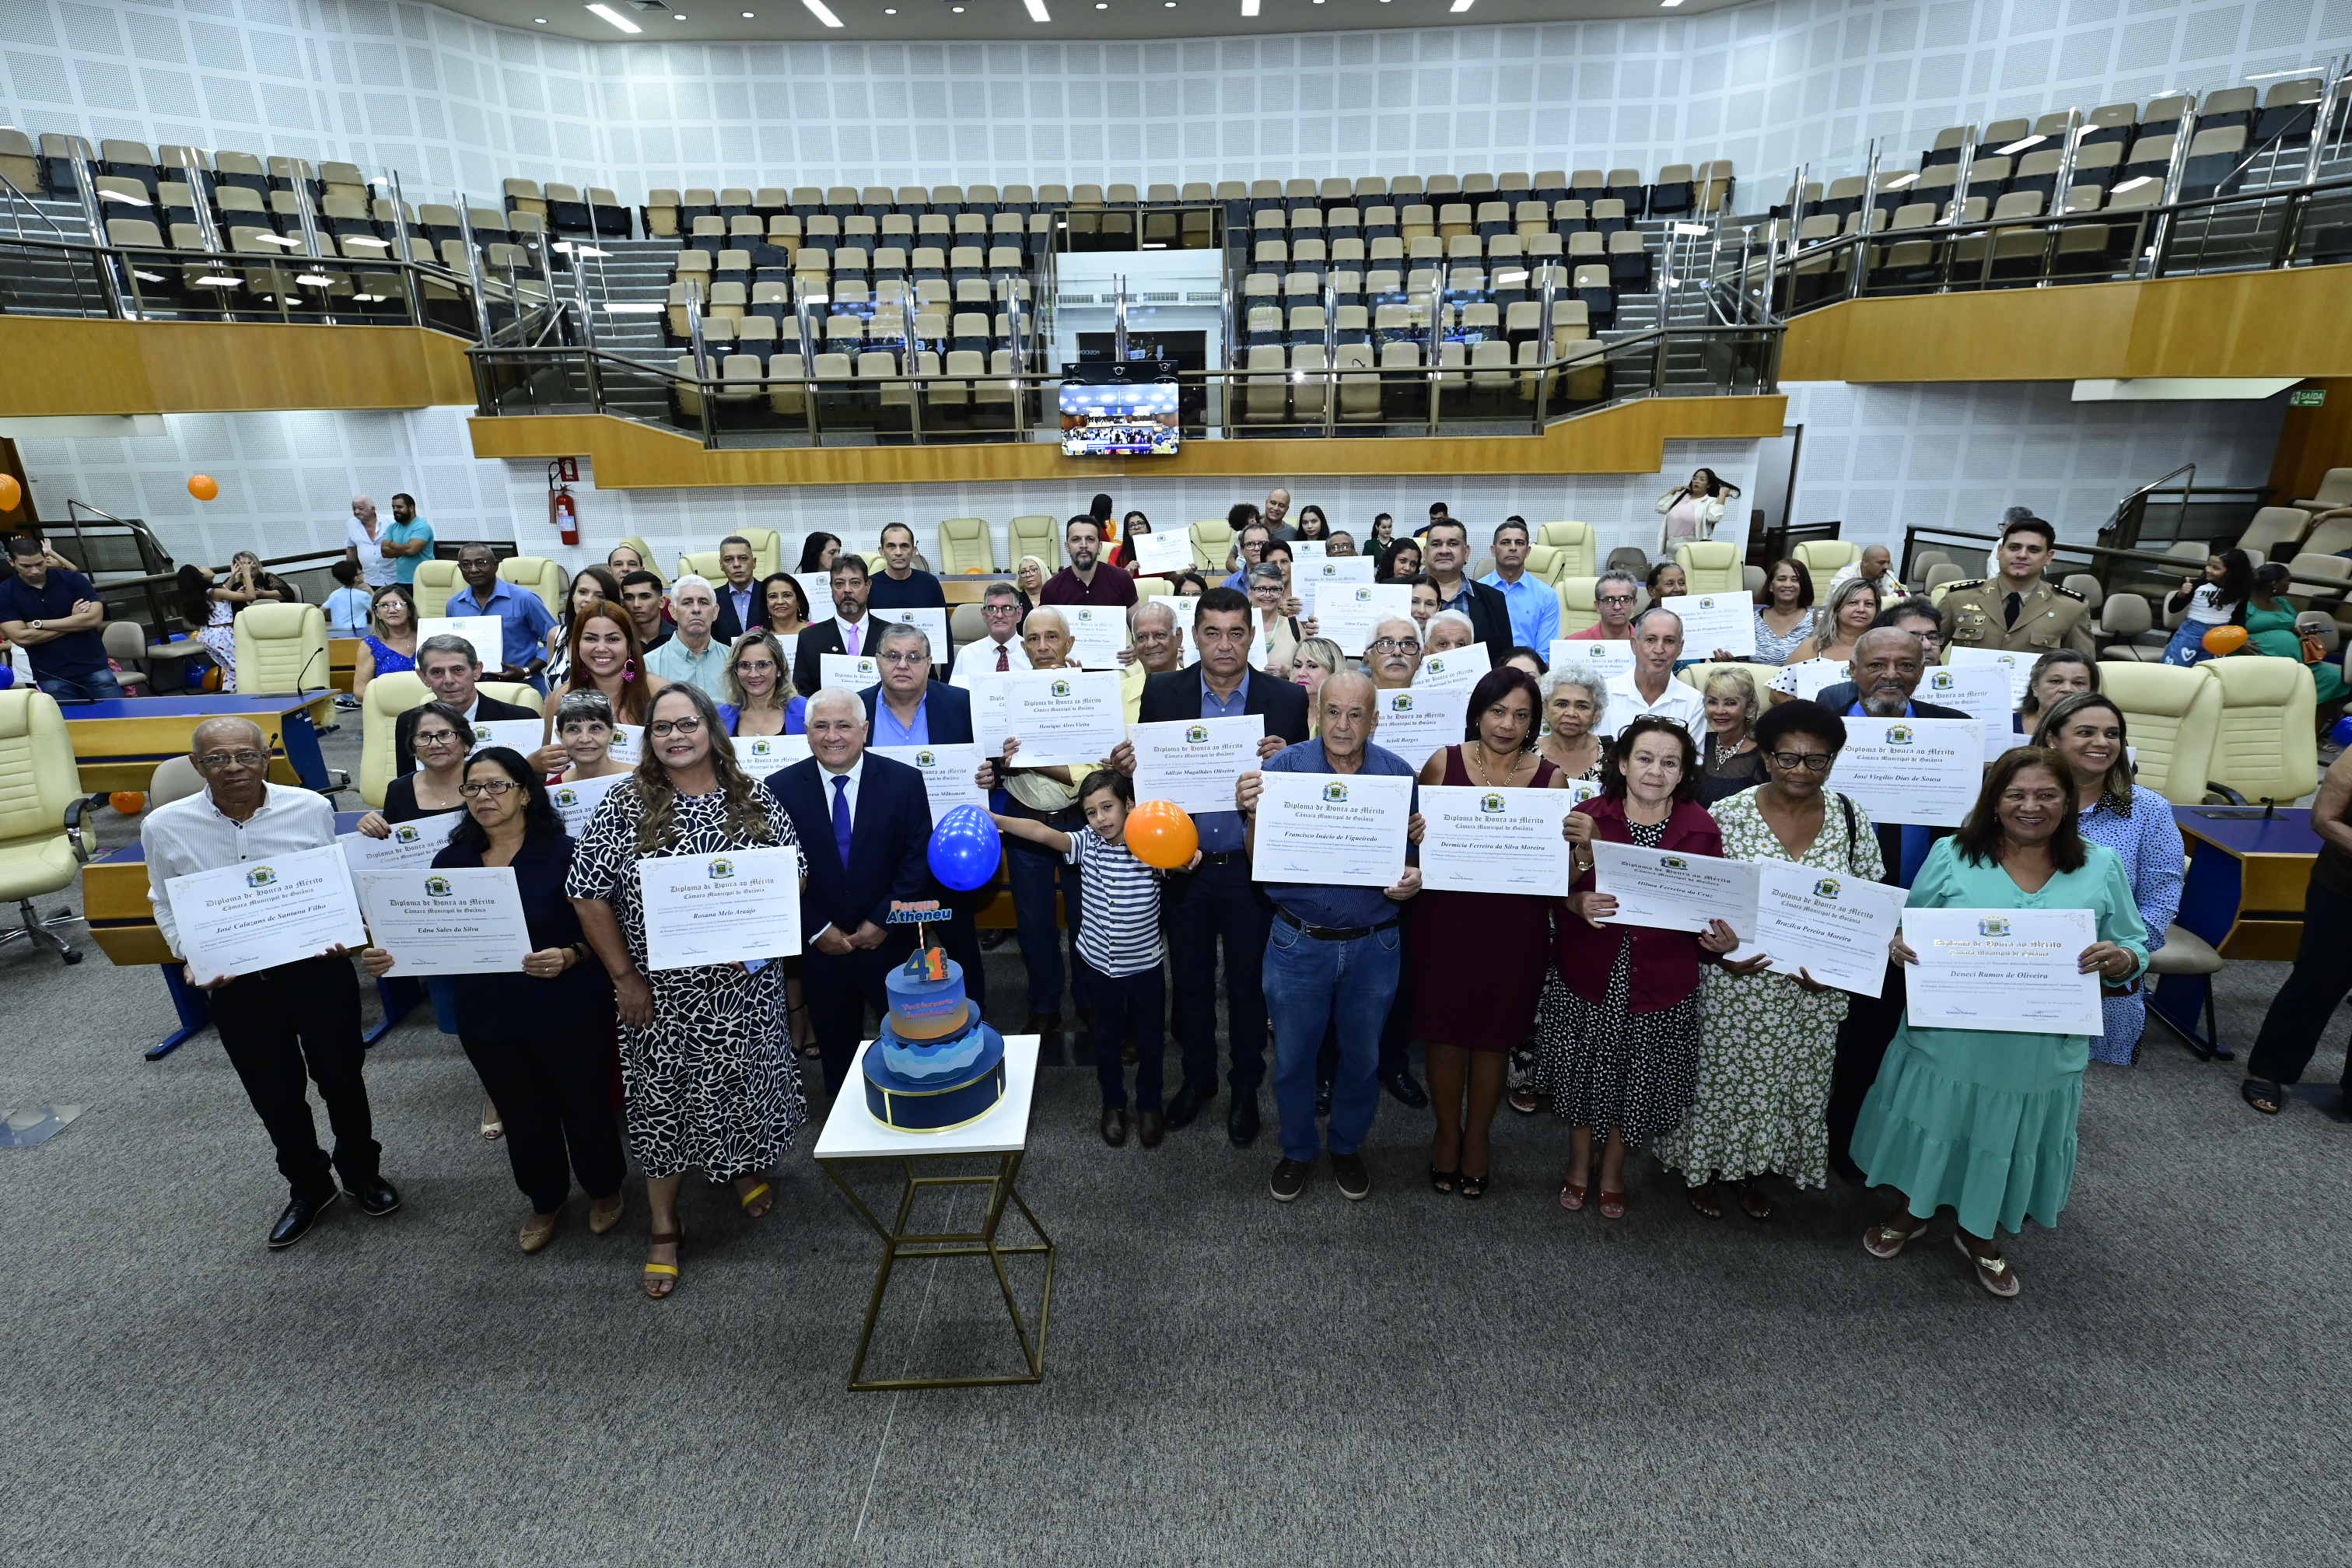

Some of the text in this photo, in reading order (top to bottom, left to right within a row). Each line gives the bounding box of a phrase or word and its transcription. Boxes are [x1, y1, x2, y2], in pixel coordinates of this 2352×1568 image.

[1284, 801, 1313, 810] Diploma
[670, 884, 702, 893] Diploma
[205, 895, 241, 907] Diploma
[257, 887, 282, 896] Honra
[1773, 888, 1801, 901] Diploma
[1814, 898, 1836, 909] Honra
[234, 917, 265, 929] Calazans
[278, 910, 305, 919] Santana
[308, 904, 326, 912] Filho
[887, 908, 950, 922] Atheneu
[1804, 906, 1830, 917] Municipal
[1802, 926, 1825, 936] Pereira
[1828, 933, 1851, 942] Moreira
[903, 947, 940, 982] 41
